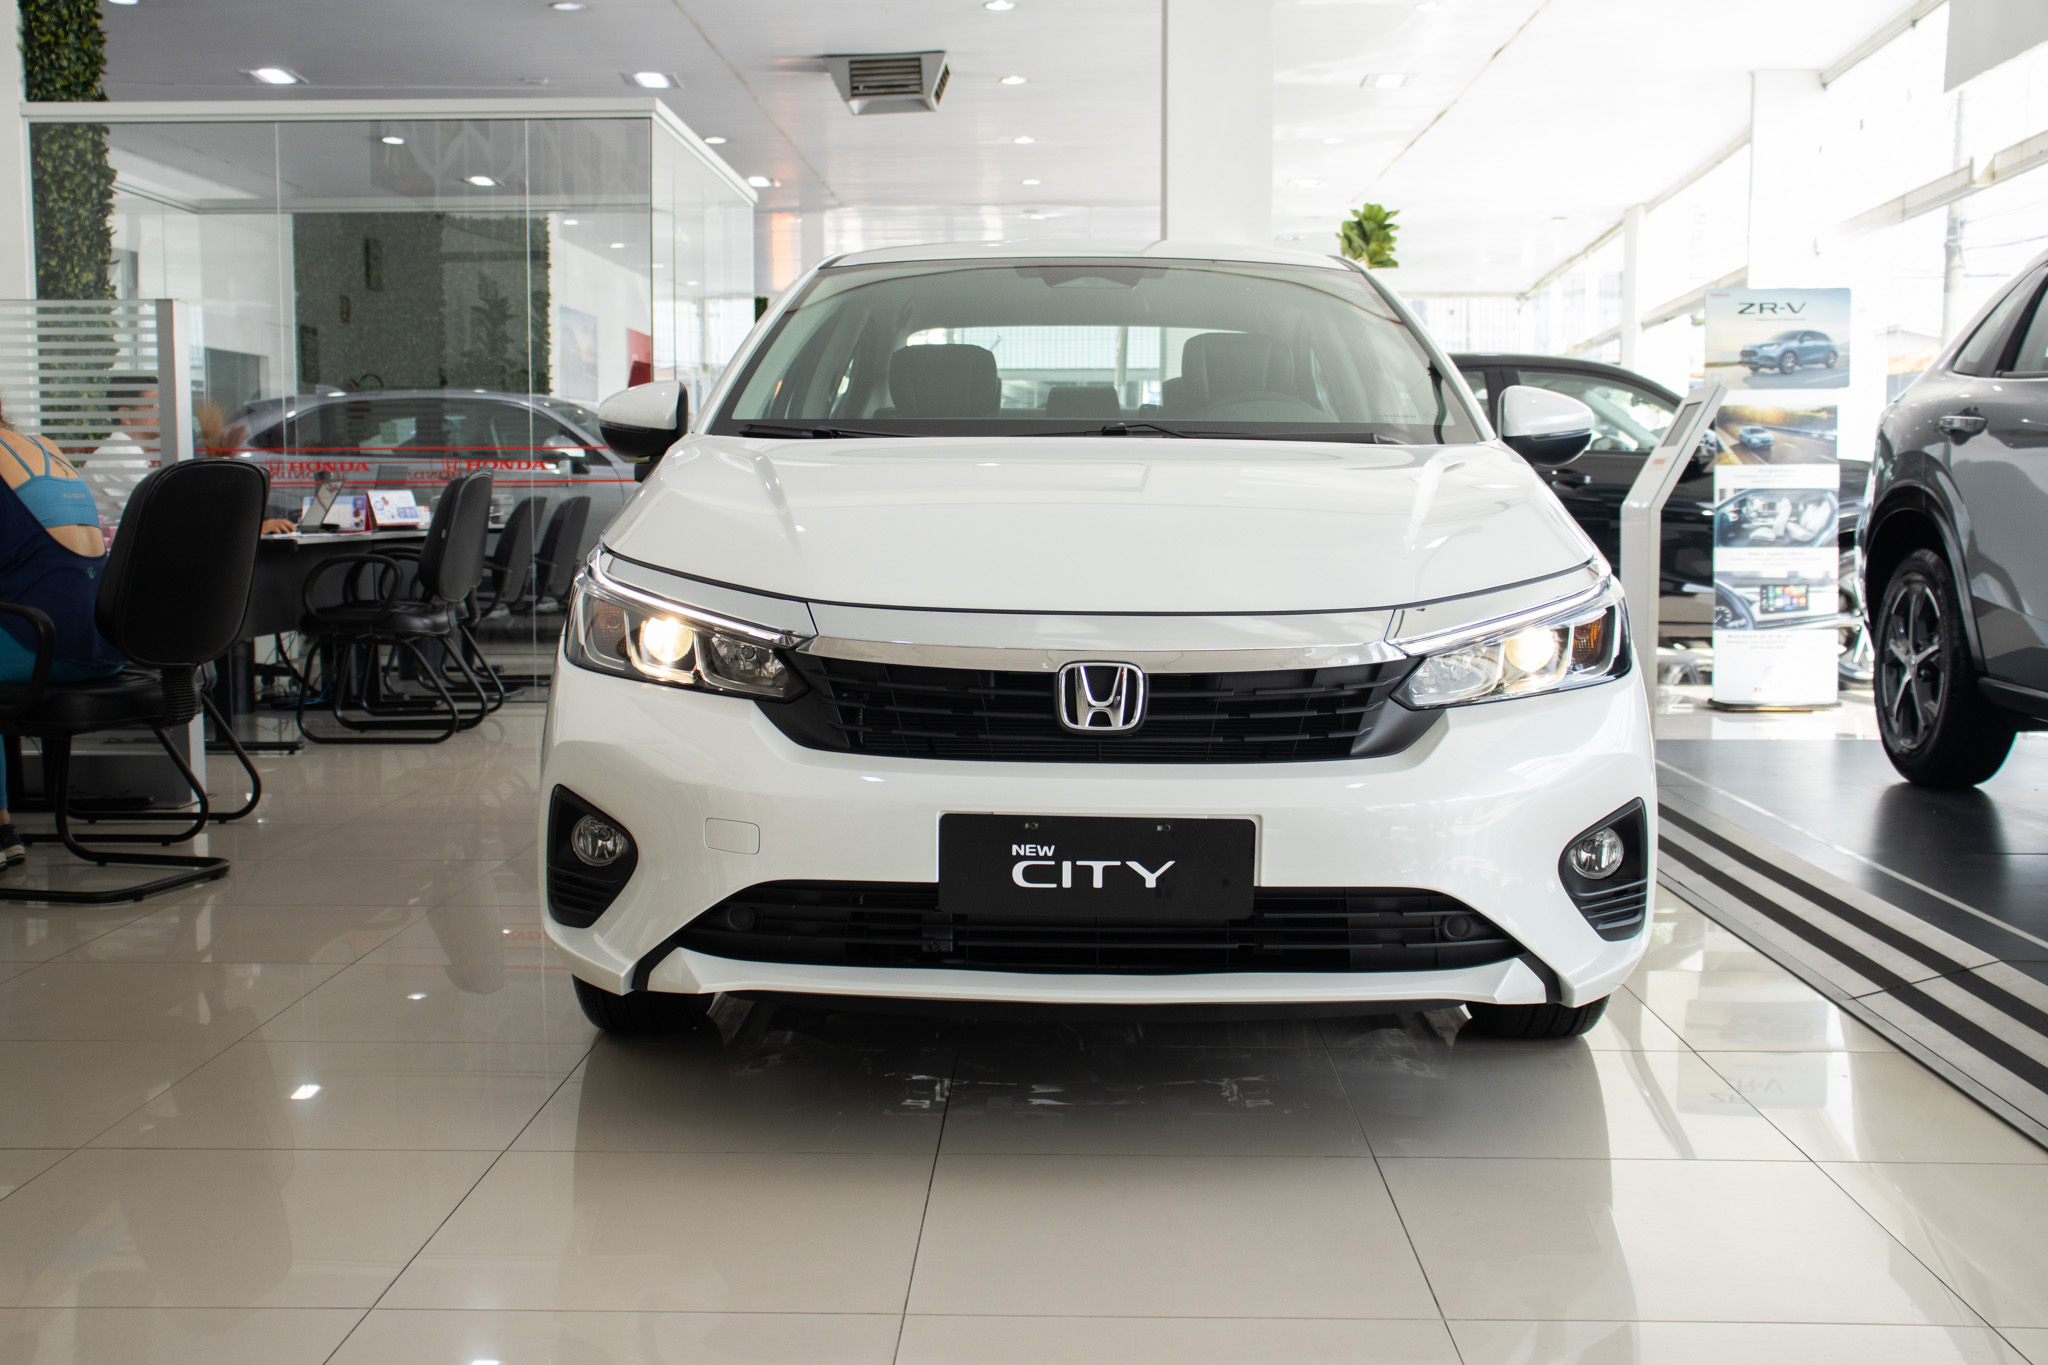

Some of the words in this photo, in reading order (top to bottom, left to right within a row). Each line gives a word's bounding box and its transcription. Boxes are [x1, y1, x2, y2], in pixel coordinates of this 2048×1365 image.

[1738, 302, 1807, 315] ZR-V
[287, 461, 370, 472] HONDA
[465, 460, 547, 470] HONDA
[1012, 844, 1055, 856] NEW
[1012, 861, 1176, 888] CITY
